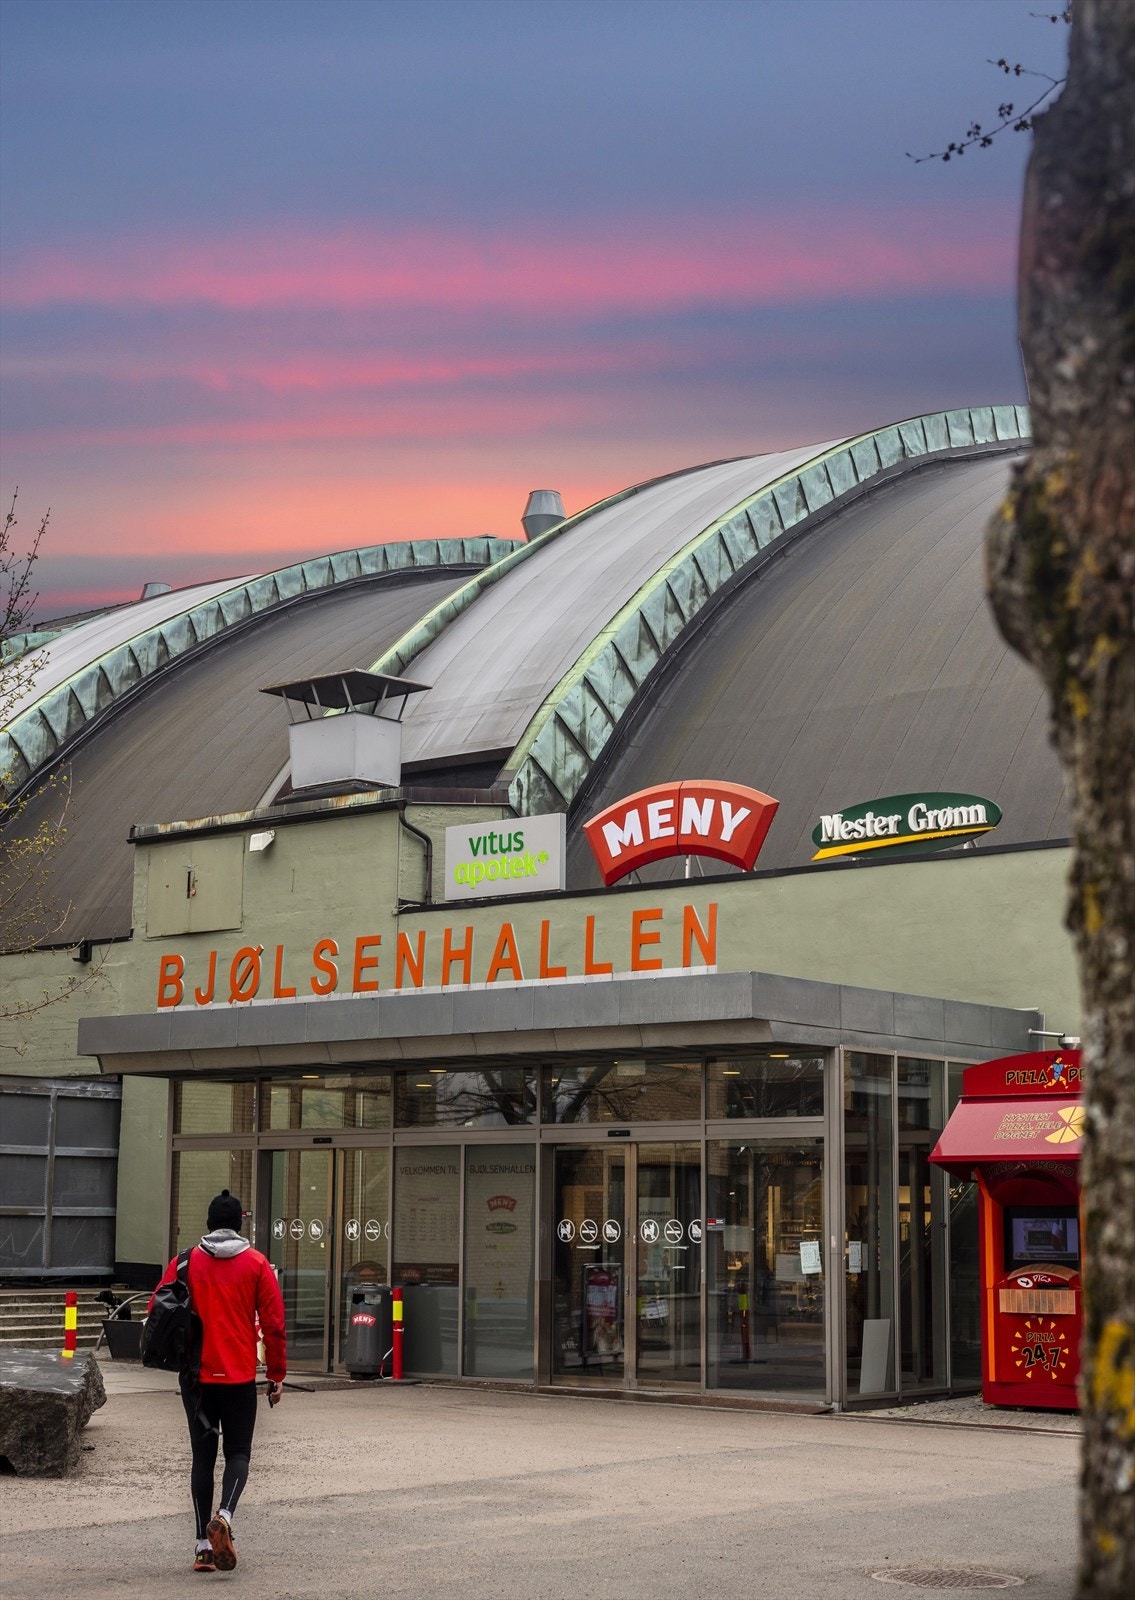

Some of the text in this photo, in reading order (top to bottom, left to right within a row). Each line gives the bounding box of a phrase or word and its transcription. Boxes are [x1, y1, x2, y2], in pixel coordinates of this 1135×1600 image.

[601, 797, 752, 858] MENY
[820, 803, 988, 842] Mester Grønn
[468, 831, 524, 857] vitus
[157, 903, 718, 1008] BJØLSENHALLEN
[1005, 1069, 1049, 1085] PIZZA
[1003, 1112, 1053, 1122] NYSTEKT
[1036, 1121, 1062, 1130] HELE
[993, 1130, 1040, 1140] DØGNET
[400, 1164, 536, 1175] VELKOMMEN TIL BJØLSENHALLEN
[353, 1315, 374, 1323] MENY
[1026, 1332, 1055, 1343] PIZZA
